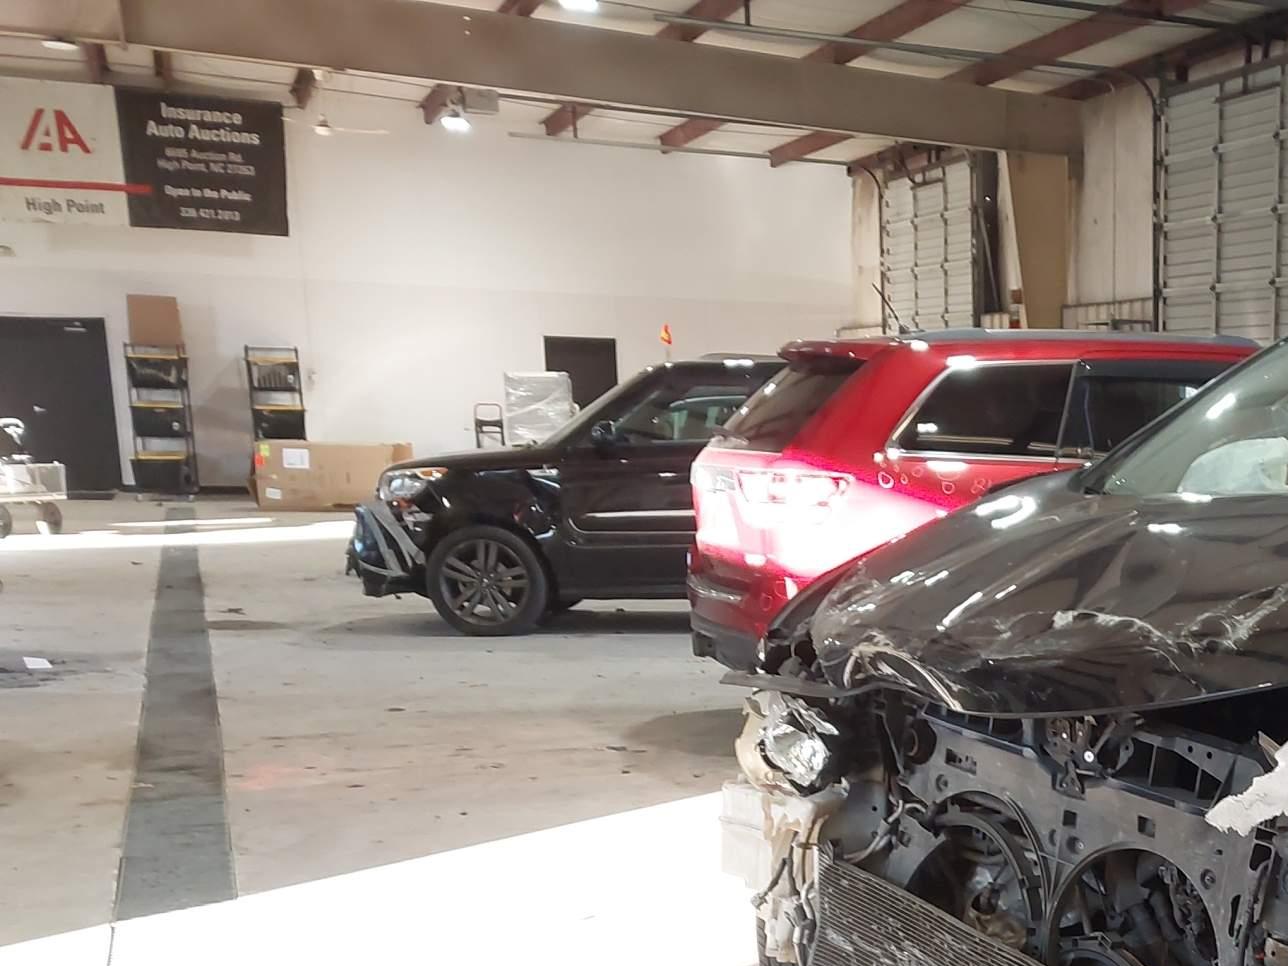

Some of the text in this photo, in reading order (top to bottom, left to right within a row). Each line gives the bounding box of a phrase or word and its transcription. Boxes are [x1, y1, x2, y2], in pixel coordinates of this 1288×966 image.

[160, 102, 242, 125] Insurance
[146, 120, 261, 145] Auto Auctions
[25, 197, 104, 215] High Point
